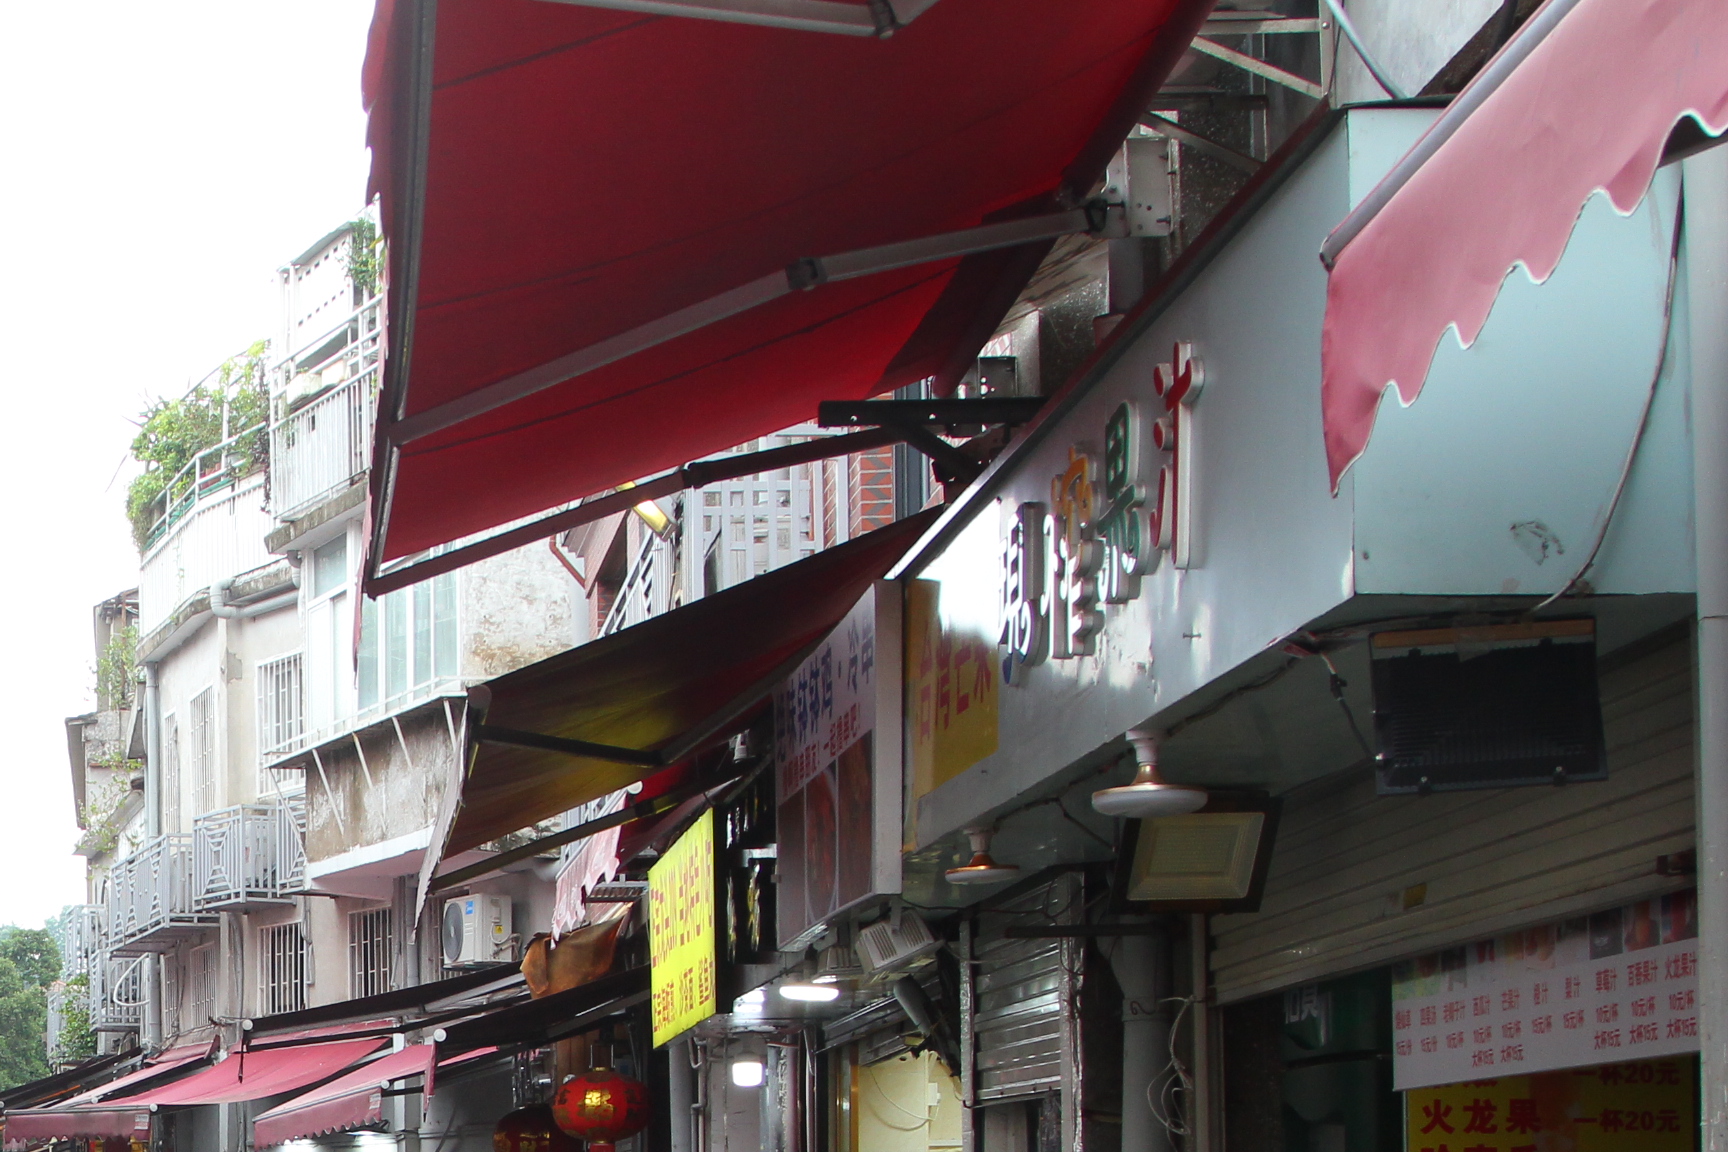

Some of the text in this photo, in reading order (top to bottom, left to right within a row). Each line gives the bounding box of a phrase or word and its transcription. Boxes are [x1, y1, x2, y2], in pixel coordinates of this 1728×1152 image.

[1627, 958, 1659, 987] 百香果汁
[1664, 951, 1698, 980] 火龙果汁
[1629, 1022, 1659, 1045] 大杯15元
[1666, 1016, 1697, 1040] 大杯15元
[1572, 1061, 1680, 1085] 一杯20元
[1420, 1099, 1681, 1135] 火龙果 一杯20元
